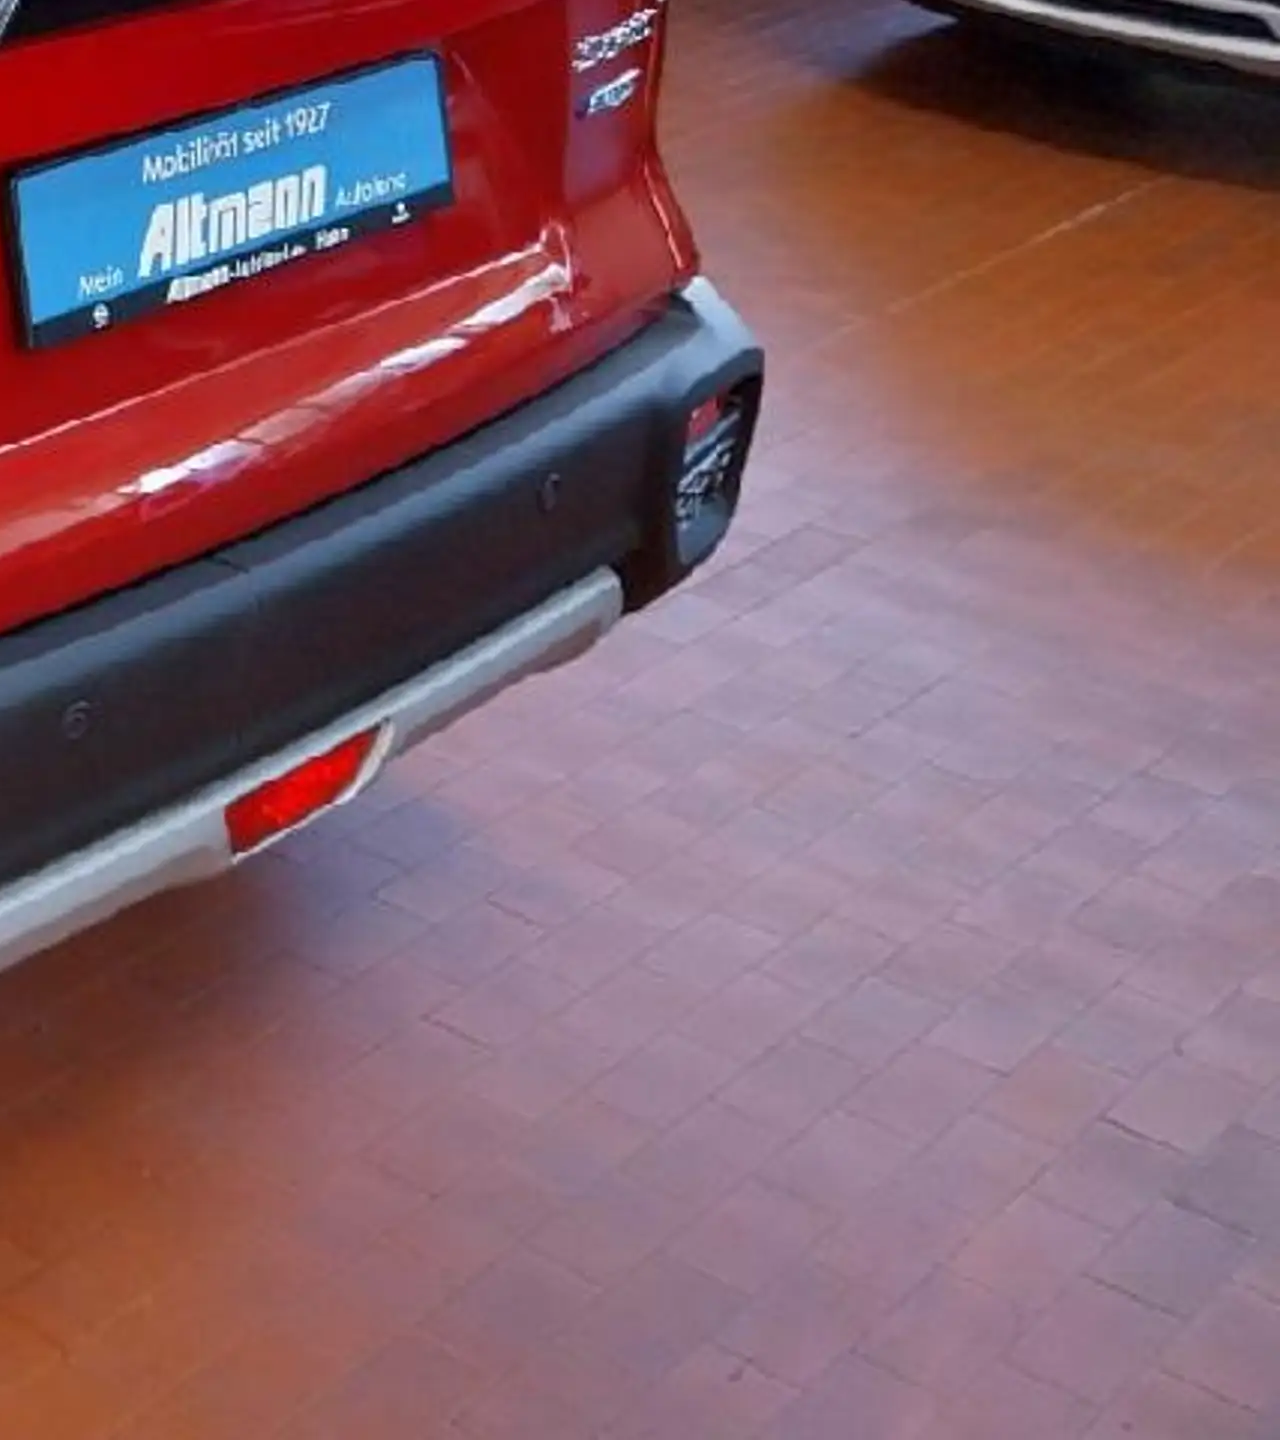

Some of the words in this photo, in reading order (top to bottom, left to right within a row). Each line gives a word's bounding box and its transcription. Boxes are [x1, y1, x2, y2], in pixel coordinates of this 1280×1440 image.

[242, 117, 282, 153] seit
[284, 101, 331, 138] 1927
[138, 164, 327, 278] Altmann
